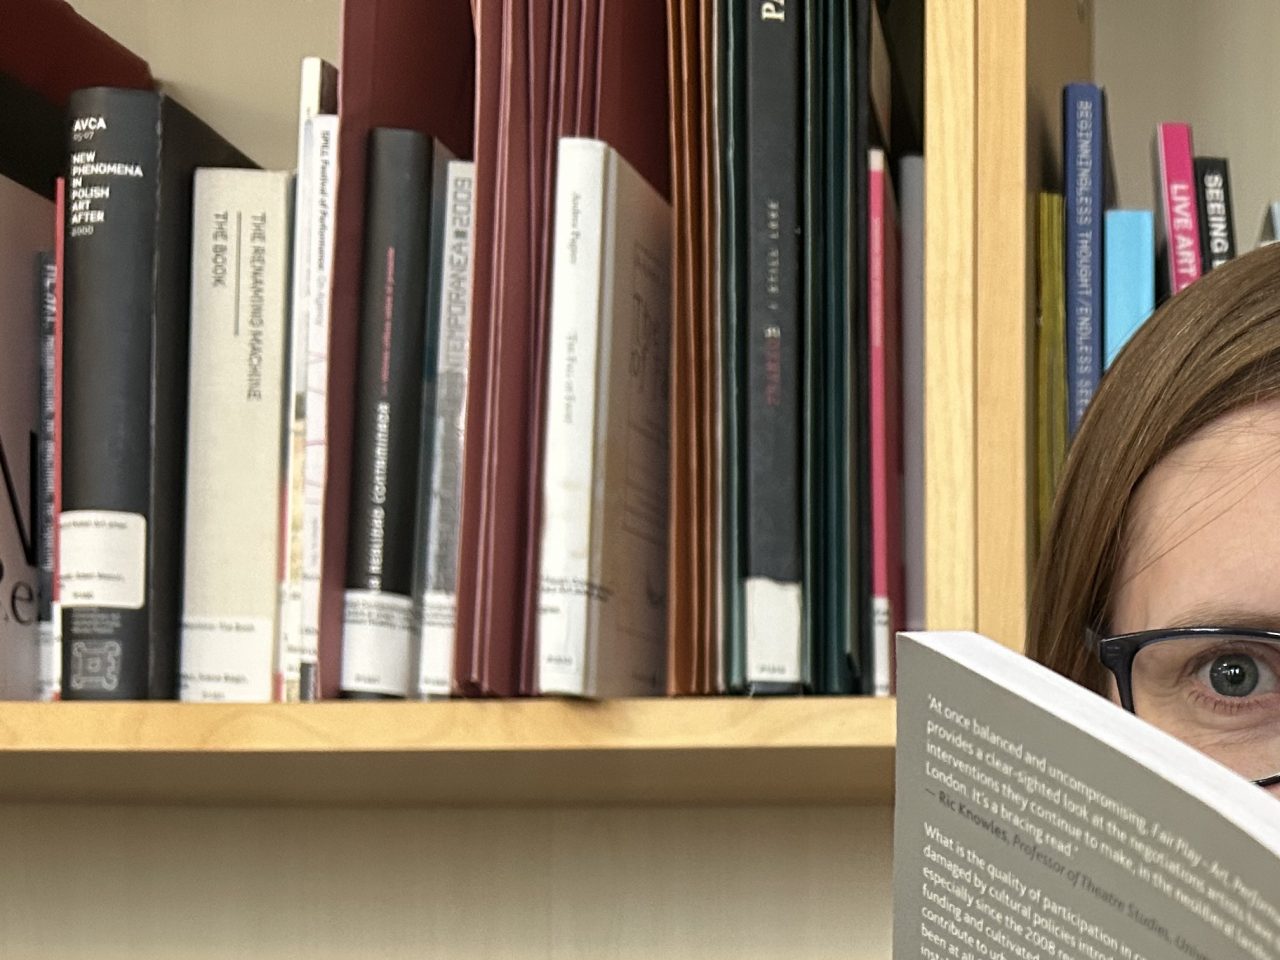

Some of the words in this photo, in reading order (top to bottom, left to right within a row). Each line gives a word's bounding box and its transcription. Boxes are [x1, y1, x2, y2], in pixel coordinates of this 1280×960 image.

[73, 117, 107, 131] AVCA
[72, 151, 95, 163] NEW
[72, 163, 143, 176] PHENOMENA
[1077, 101, 1092, 225] BEGINNINGLESS
[72, 177, 82, 188] IN
[72, 186, 109, 199] POLISH
[72, 200, 91, 211] ART
[72, 210, 104, 224] AFTER
[1171, 183, 1192, 229] LIVE
[1204, 174, 1229, 254] SEEING
[214, 212, 228, 241] THE
[250, 212, 266, 242] THE
[212, 245, 227, 287] BOOK
[1176, 235, 1197, 276] ART
[249, 246, 265, 326] RENAMING
[247, 330, 263, 401] MACHINE
